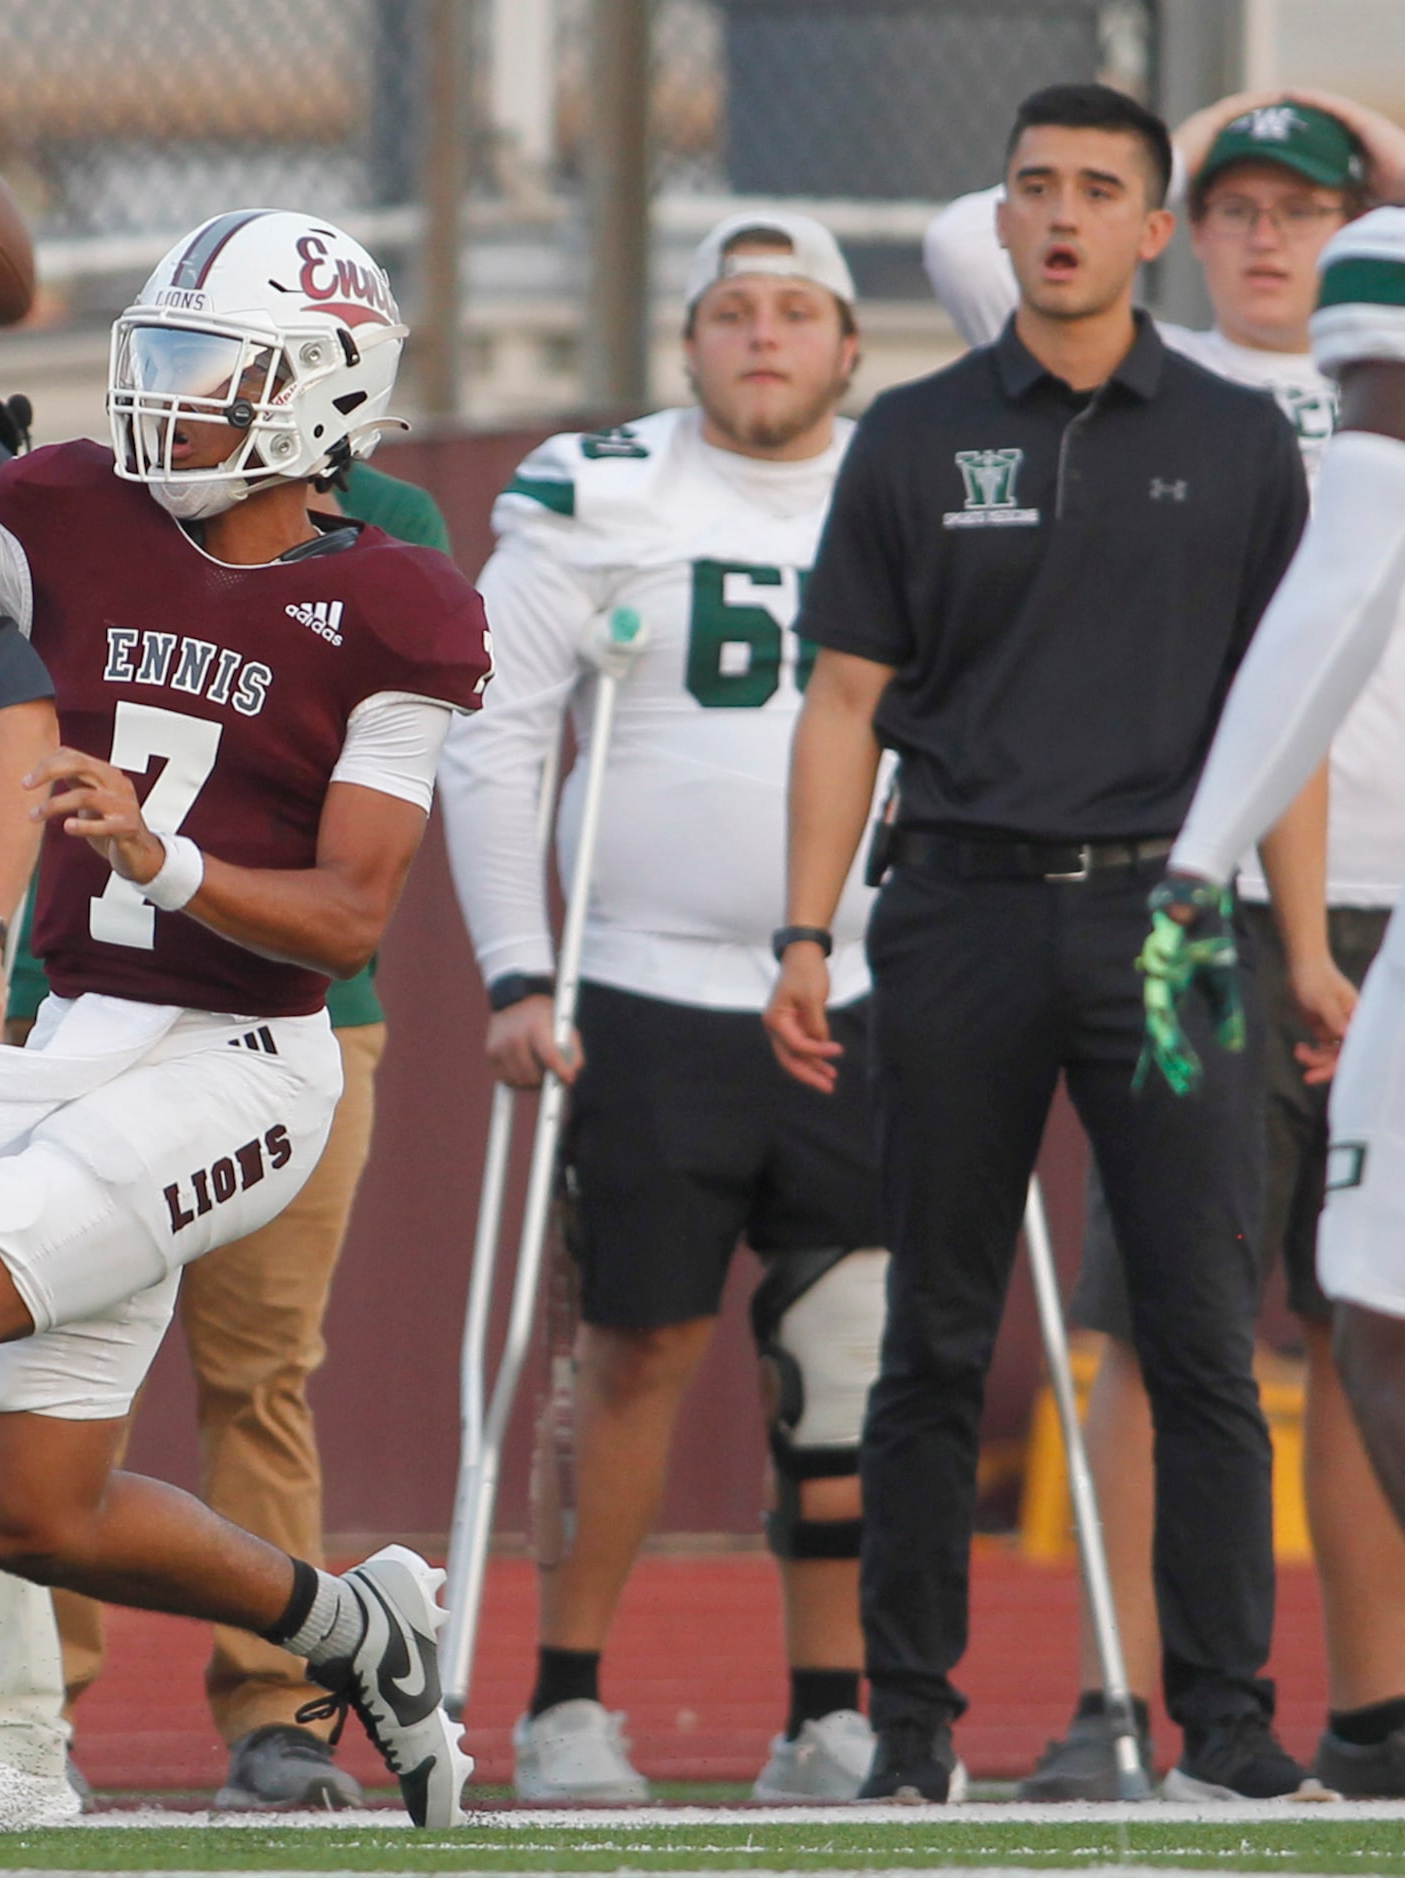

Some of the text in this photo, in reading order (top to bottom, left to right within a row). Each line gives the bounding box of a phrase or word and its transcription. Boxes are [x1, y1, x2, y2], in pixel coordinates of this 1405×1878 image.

[155, 290, 206, 311] LIONS
[104, 628, 273, 717] ENNIS
[285, 603, 344, 647] adidas
[685, 558, 819, 708] 6
[89, 700, 223, 951] 7
[163, 1123, 292, 1235] LIONS
